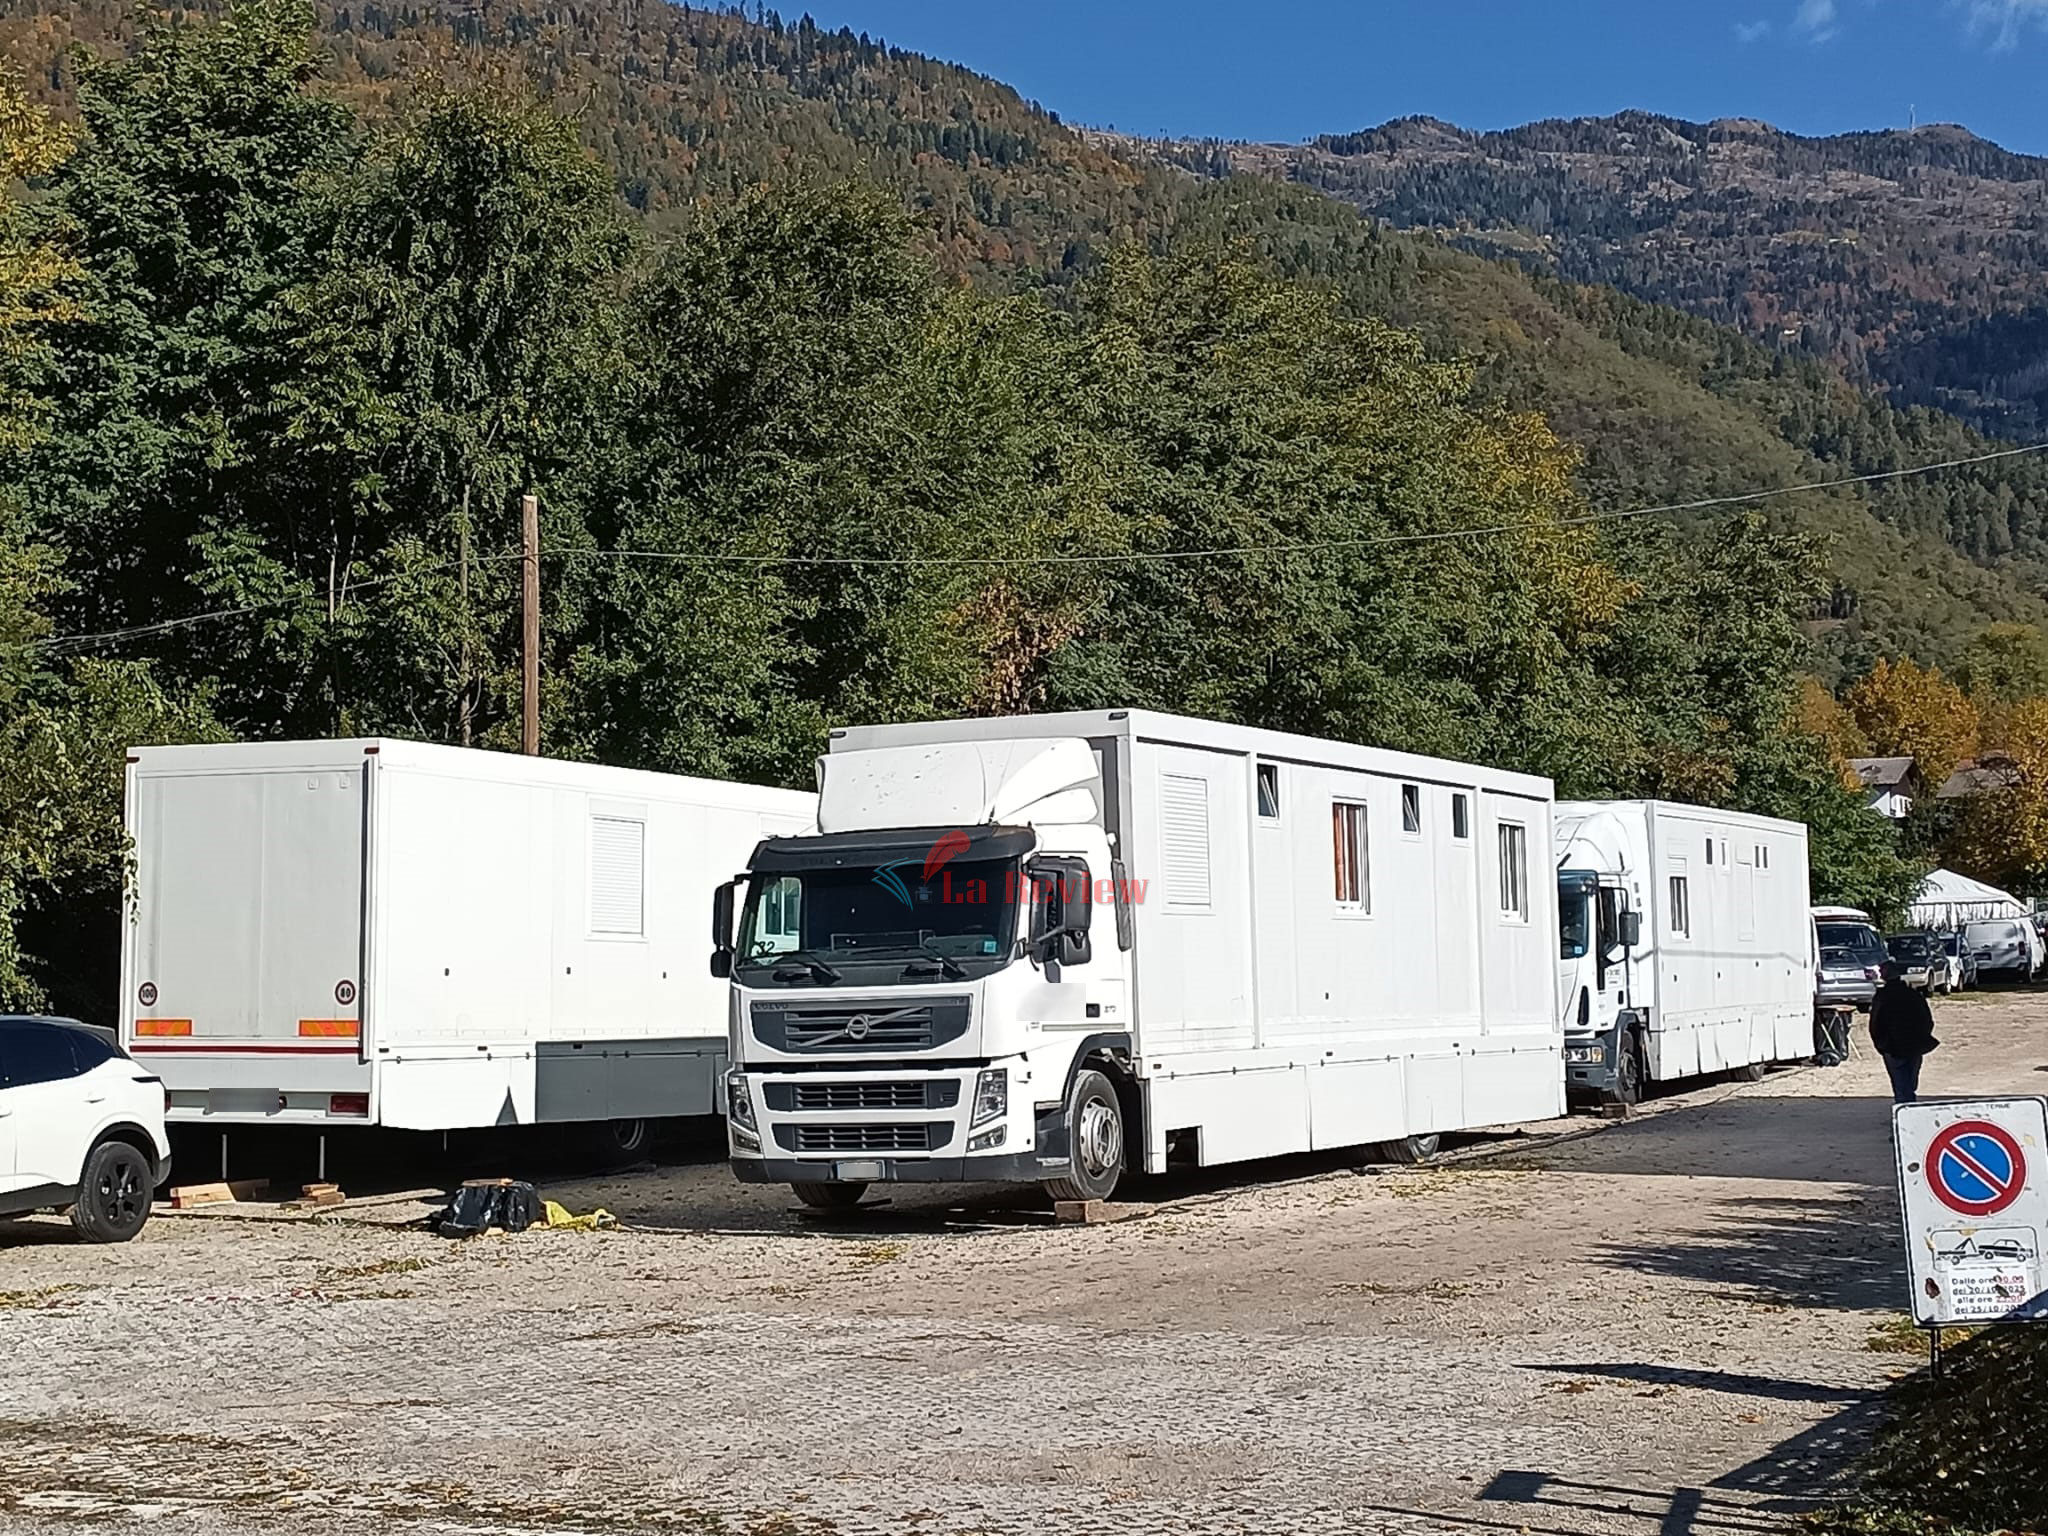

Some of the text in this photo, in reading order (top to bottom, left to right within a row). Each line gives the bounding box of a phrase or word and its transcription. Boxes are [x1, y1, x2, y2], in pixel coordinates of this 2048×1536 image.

[142, 988, 154, 999] 100
[340, 987, 351, 998] 80
[1952, 1277, 1976, 1285] Dalle
[1952, 1287, 1967, 1295] del
[1957, 1296, 1974, 1304] alle
[1954, 1306, 1968, 1315] del
